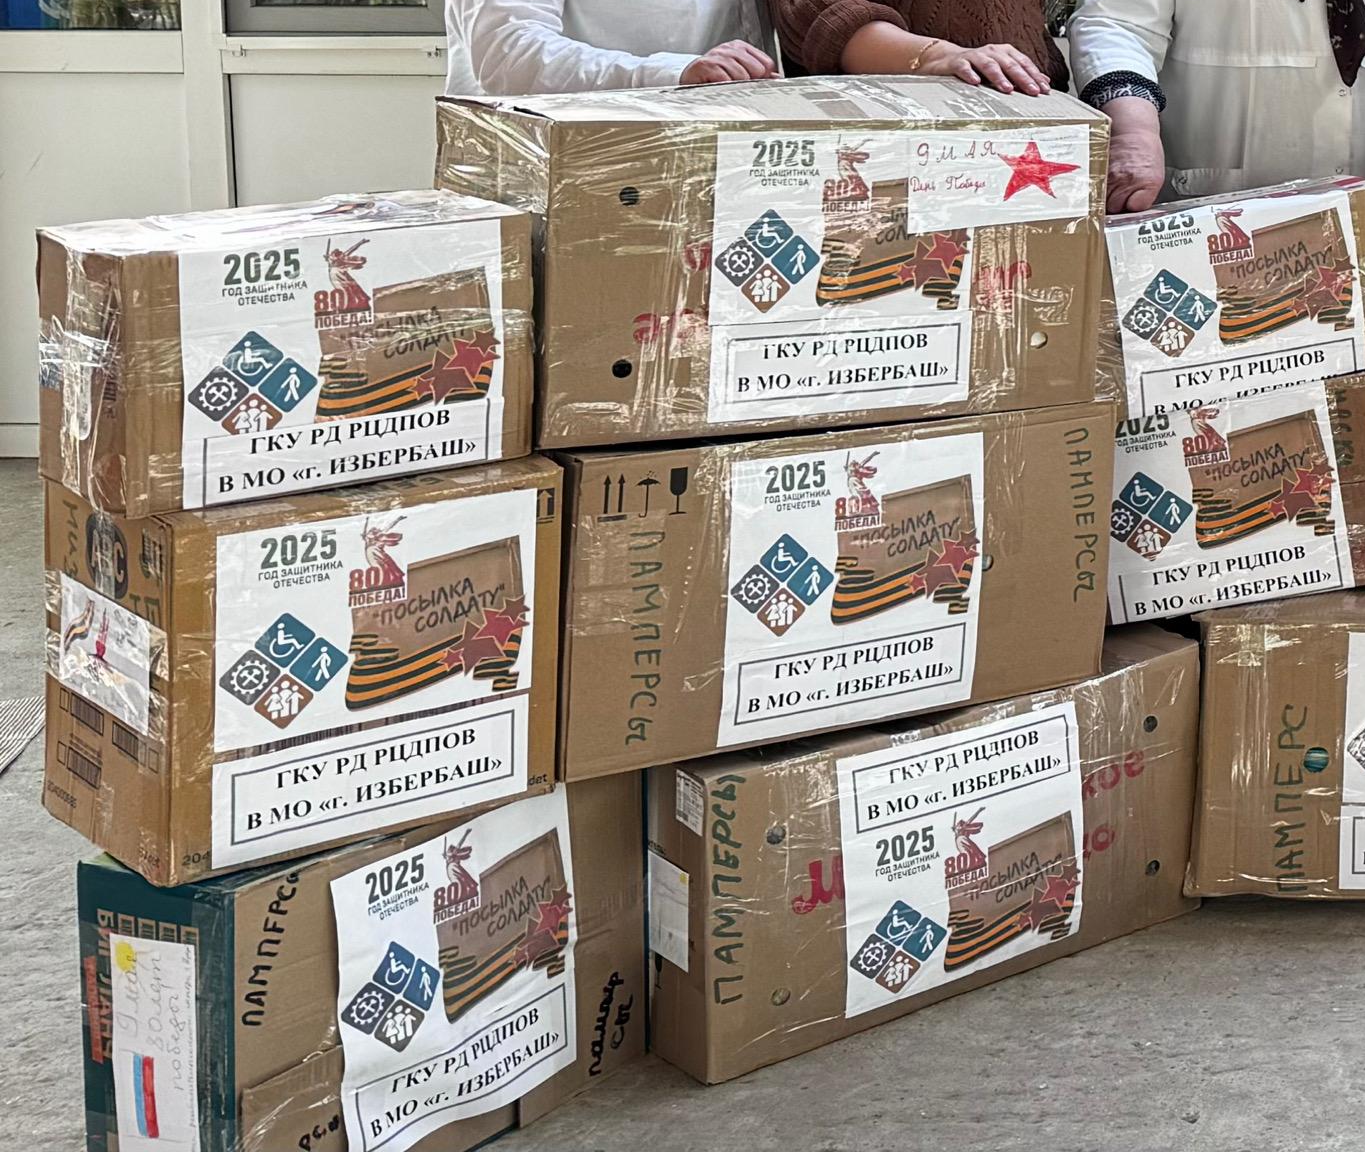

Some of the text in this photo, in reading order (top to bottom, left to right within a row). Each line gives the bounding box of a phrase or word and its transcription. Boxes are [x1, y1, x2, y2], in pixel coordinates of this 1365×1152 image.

[752, 140, 816, 167] 2025
[223, 248, 301, 286] 2025
[250, 409, 451, 454] ГКУ РД РЦДПОВ
[219, 437, 477, 493] В МО «г. ИЗБЕРБАШ»
[765, 460, 827, 494] 2025
[260, 527, 338, 570] 2025
[258, 559, 344, 582] ГОД ЗАЩИТНИКА
[273, 572, 330, 590] ОТЕЧЕСТВА
[348, 586, 405, 607] ПОБЕДА!
[876, 824, 935, 868] 2025
[365, 853, 425, 905] 2025
